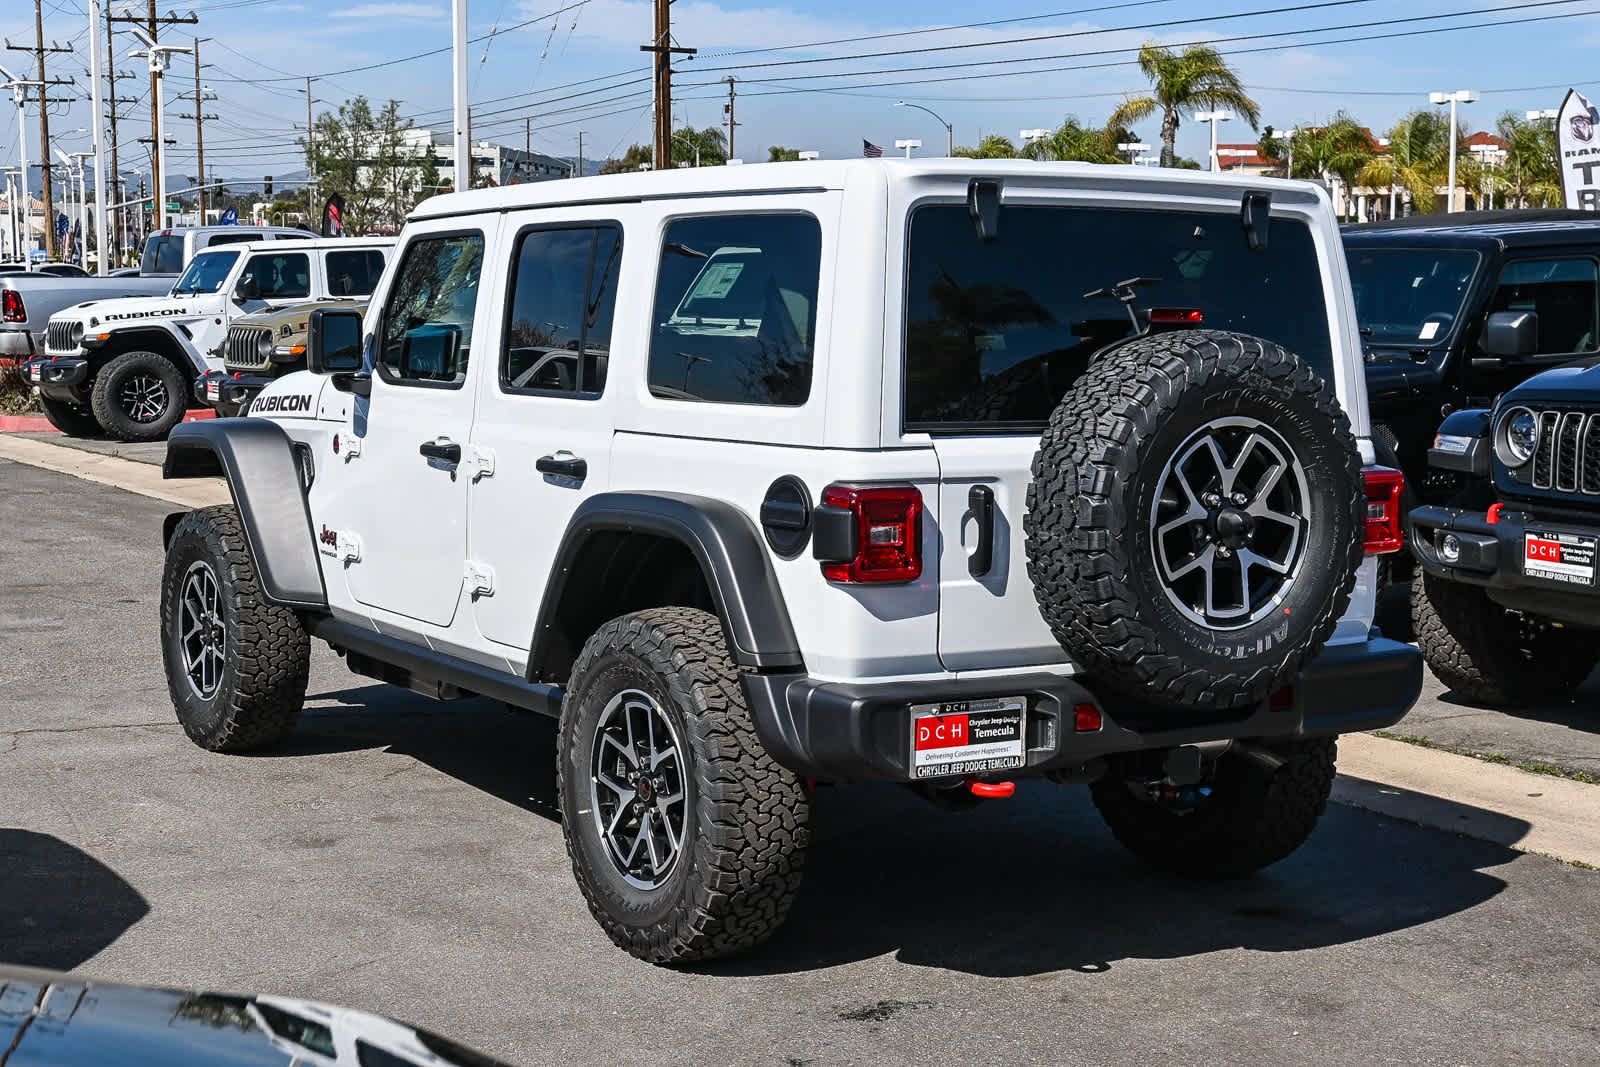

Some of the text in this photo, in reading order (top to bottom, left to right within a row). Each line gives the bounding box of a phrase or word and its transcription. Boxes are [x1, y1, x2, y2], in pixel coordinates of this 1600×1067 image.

[105, 308, 187, 321] RUBICON
[252, 395, 312, 412] RUBICON
[969, 718, 990, 727] Chrysler
[991, 716, 1003, 725] Jeep
[974, 725, 1015, 738] Temecula
[925, 752, 954, 761] Delivering
[917, 756, 1020, 777] CHRYSLER JEEP DODGE TEMECULA
